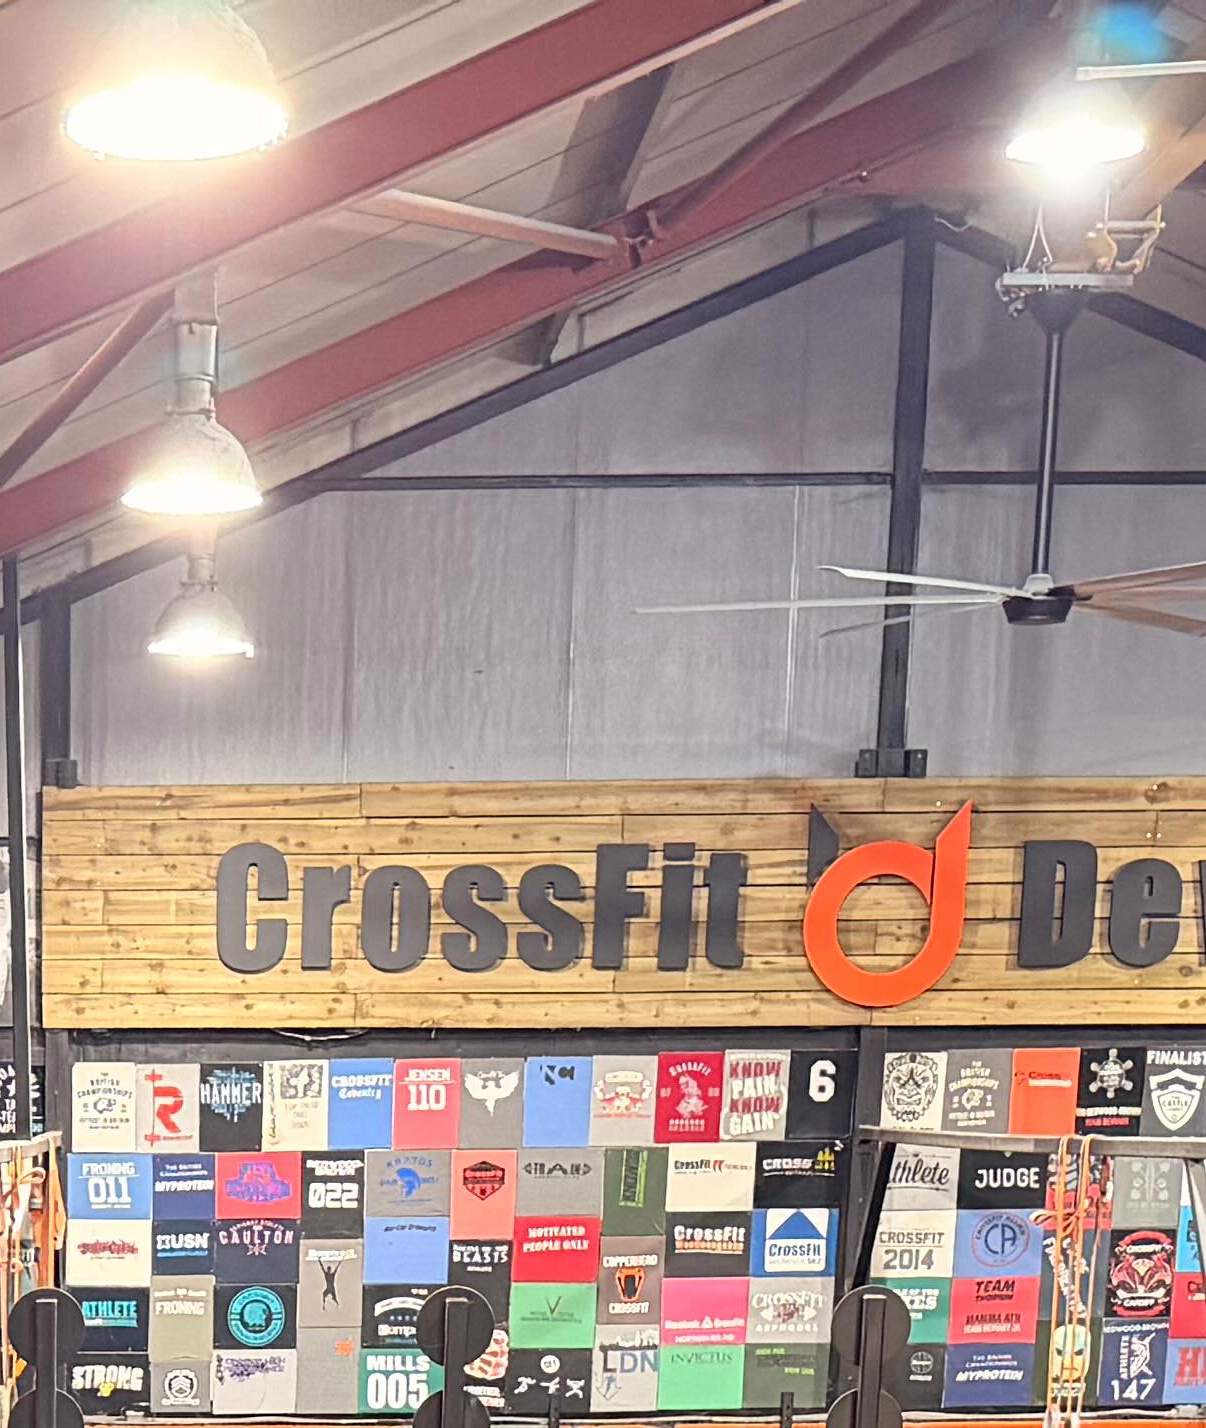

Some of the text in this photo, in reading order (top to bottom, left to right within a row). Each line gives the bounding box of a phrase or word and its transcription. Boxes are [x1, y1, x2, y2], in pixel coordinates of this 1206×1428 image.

[216, 838, 1206, 973] CrossFit De
[730, 1061, 782, 1078] KNOW
[808, 1060, 837, 1102] 6
[200, 1082, 262, 1105] HAMMER
[407, 1084, 446, 1111] 110
[729, 1096, 781, 1113] KNOW
[82, 1162, 135, 1176] FRONING
[889, 1158, 950, 1186] thlete
[975, 1168, 1040, 1189] JUDGE
[308, 1182, 359, 1208] 022
[171, 1233, 210, 1249] USN
[674, 1225, 745, 1242] CrossFit
[879, 1231, 944, 1244] CROSSFIT
[522, 1241, 561, 1252] PEOPLE
[769, 1243, 821, 1258] CrossFit
[882, 1249, 935, 1270] 2014
[976, 1280, 1015, 1294] TEAM
[752, 1291, 825, 1309] CROSSFIT
[81, 1301, 138, 1318] ATHLETE
[366, 1355, 431, 1371] MILLS
[671, 1352, 733, 1365] INVICTUS
[72, 1364, 144, 1391] STRONG
[367, 1372, 429, 1410] 005
[1110, 1378, 1156, 1401] 147
